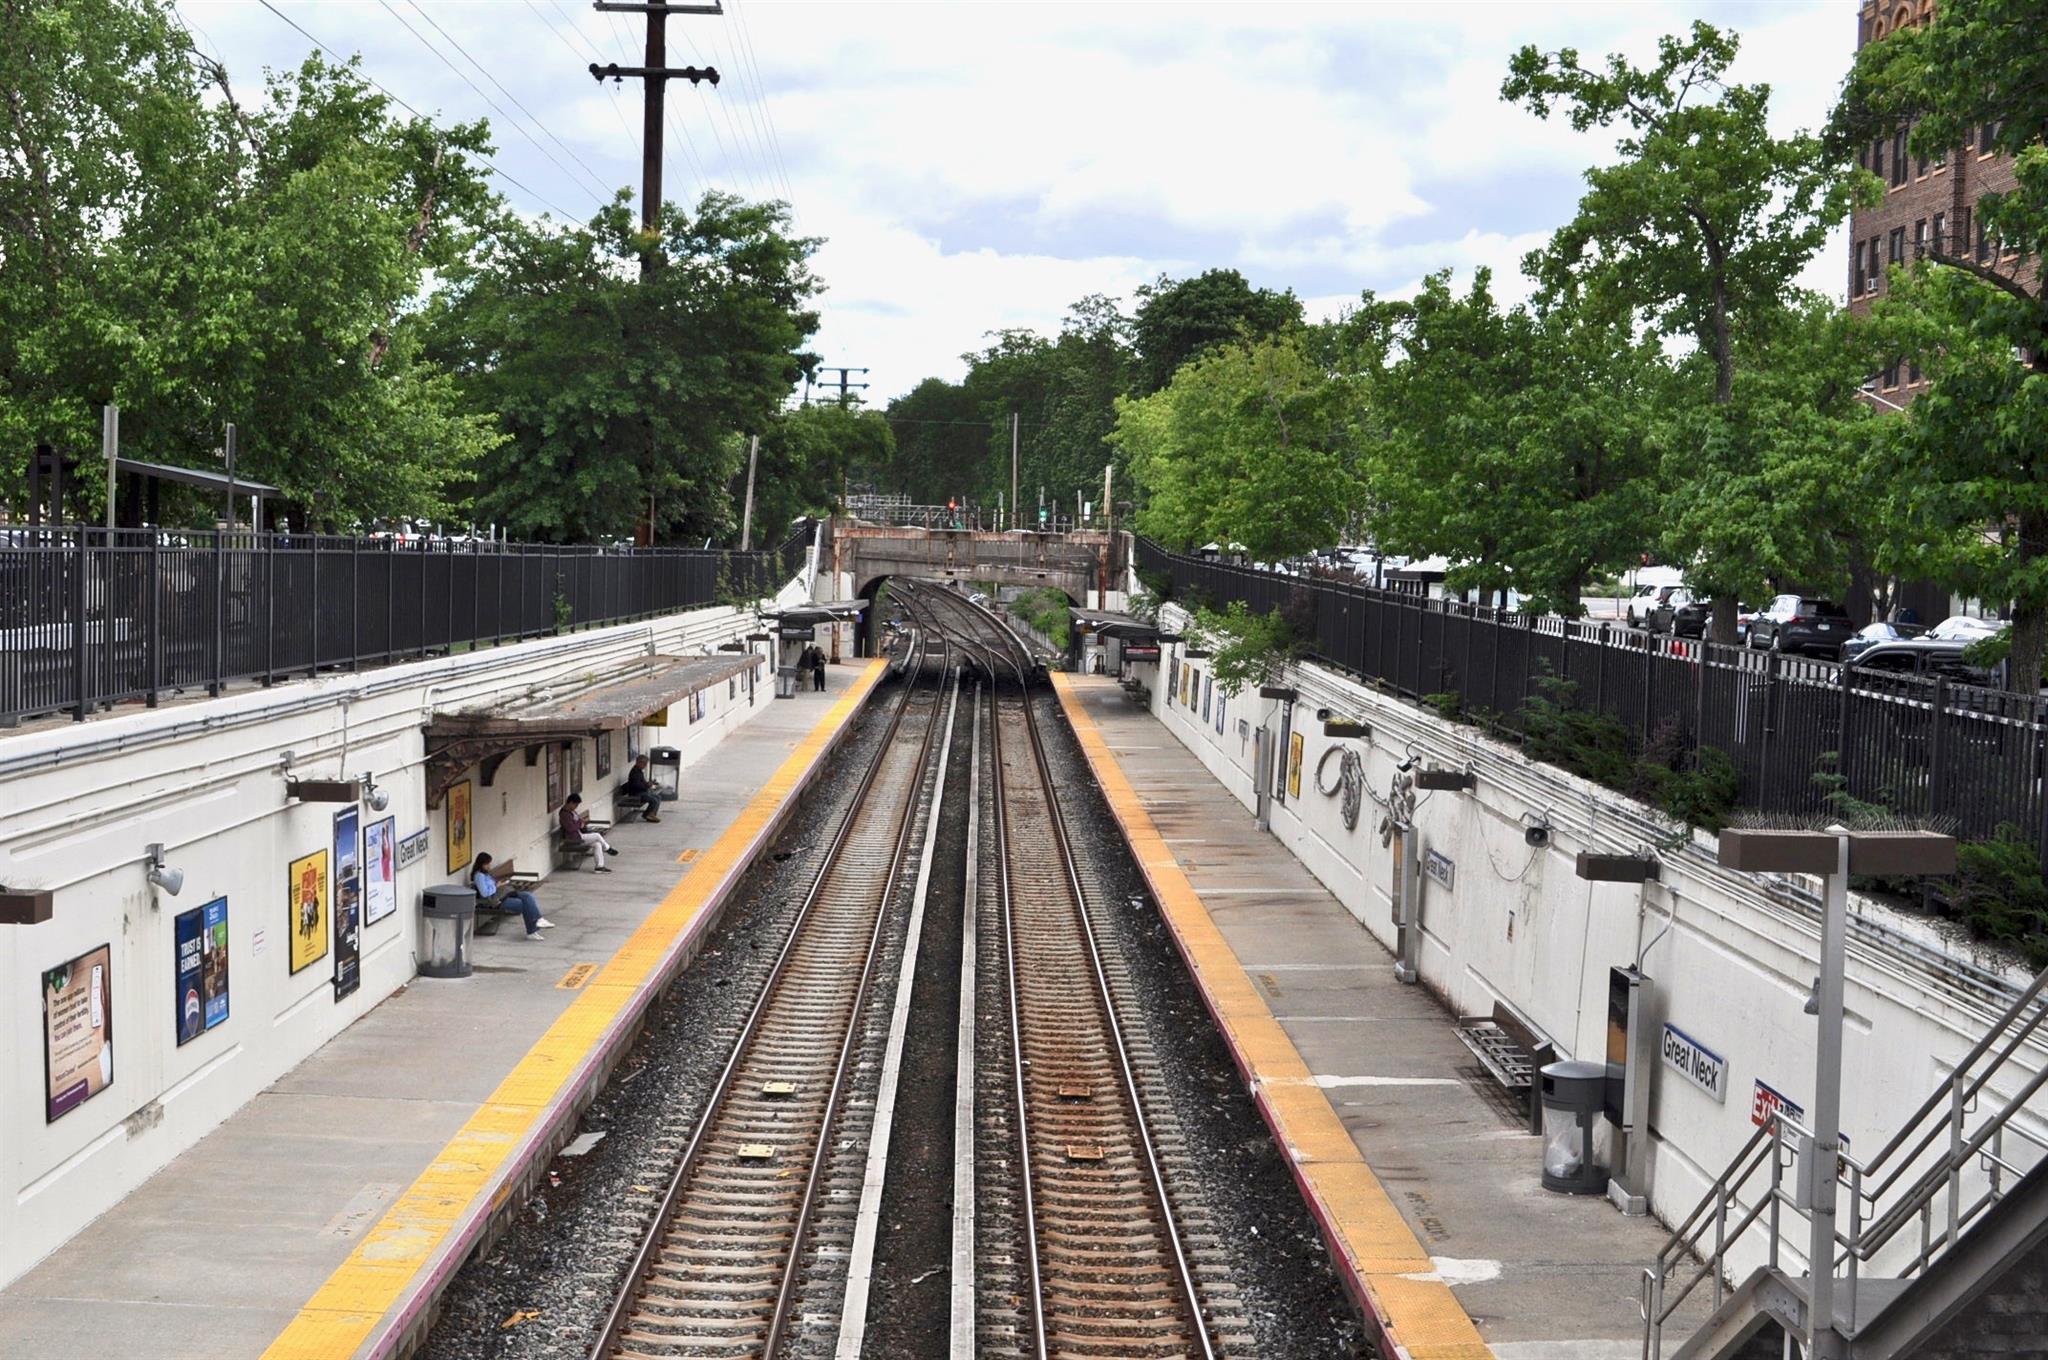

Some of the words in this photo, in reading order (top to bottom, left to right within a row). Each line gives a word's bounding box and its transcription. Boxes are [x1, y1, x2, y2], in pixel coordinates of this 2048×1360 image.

[400, 839, 415, 864] Great
[416, 833, 429, 856] Neck
[181, 938, 196, 957] TRUST
[196, 936, 202, 952] IS
[1663, 1030, 1691, 1073] Great
[1691, 1048, 1719, 1092] Neck
